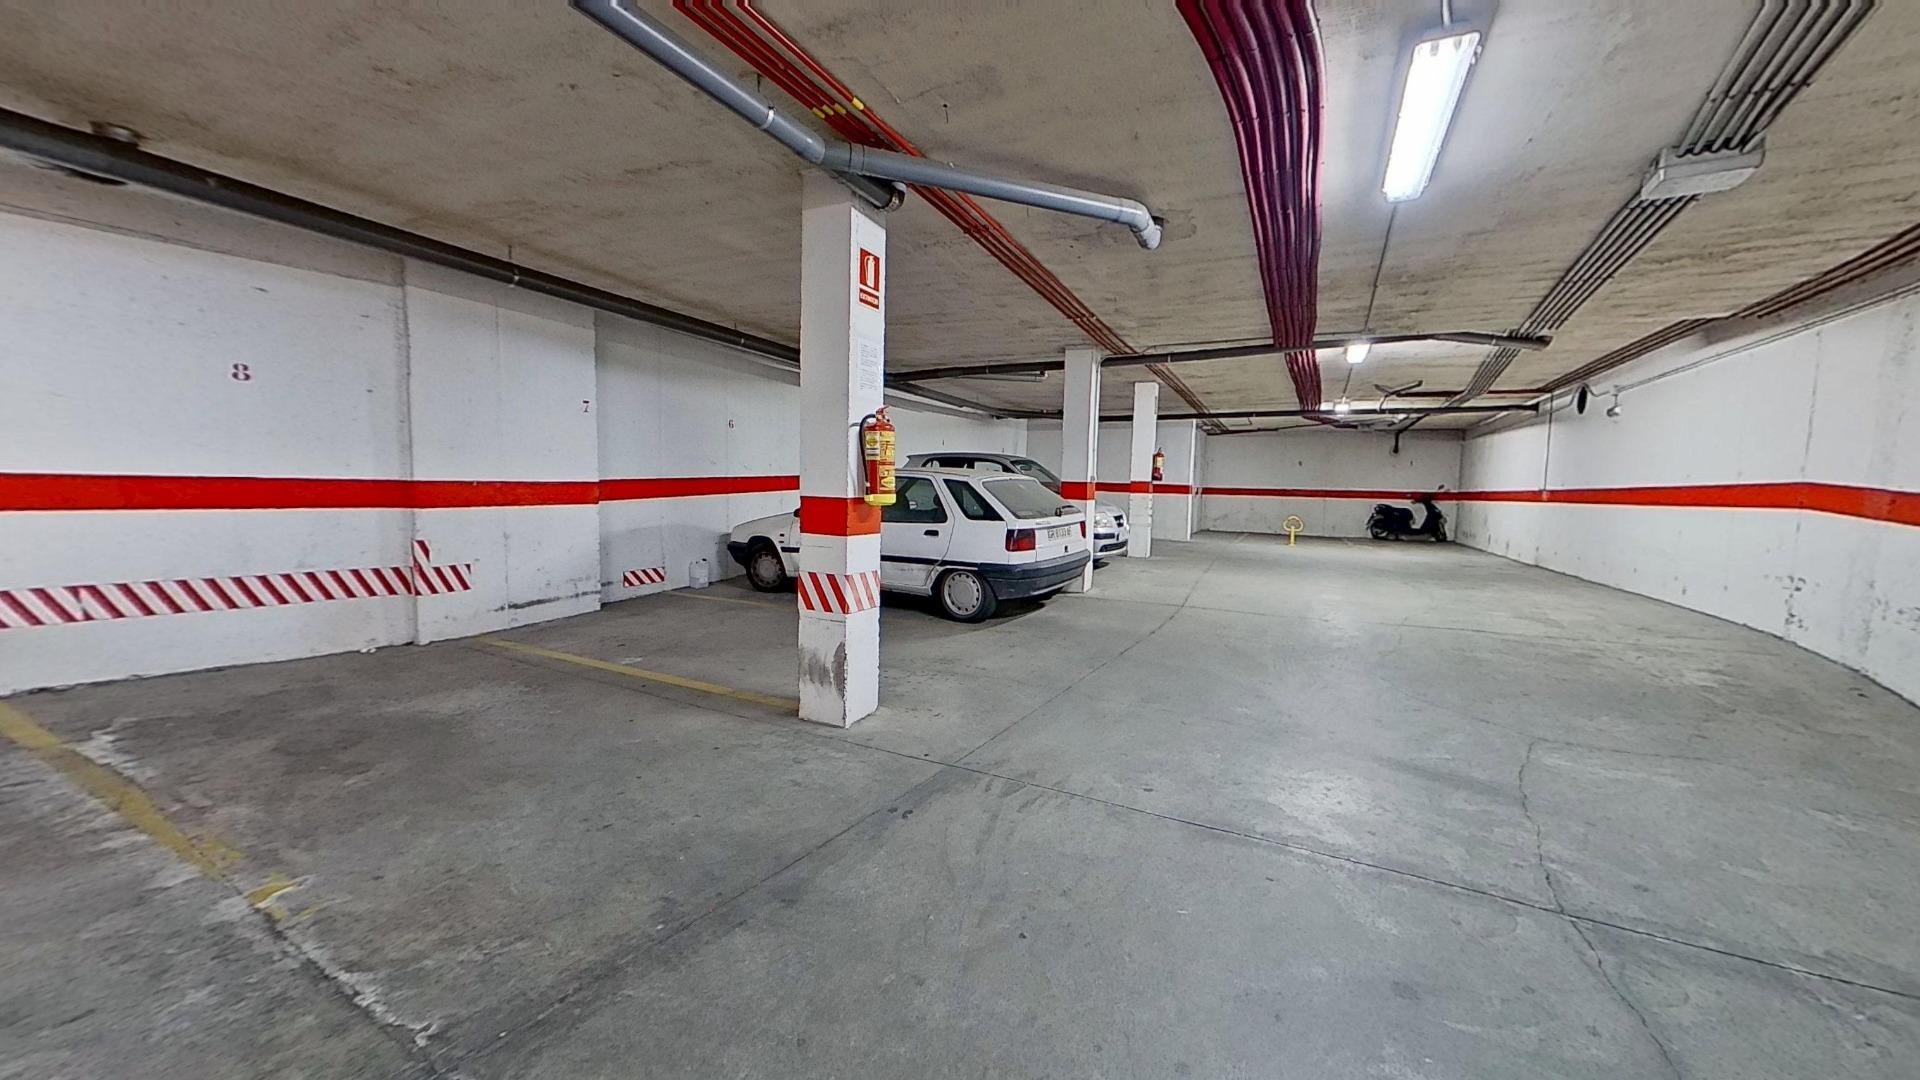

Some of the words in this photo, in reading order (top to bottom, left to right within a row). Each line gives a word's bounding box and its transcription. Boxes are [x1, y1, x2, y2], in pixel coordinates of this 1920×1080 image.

[231, 363, 251, 381] 8
[582, 400, 590, 413] 7
[728, 419, 735, 429] 6
